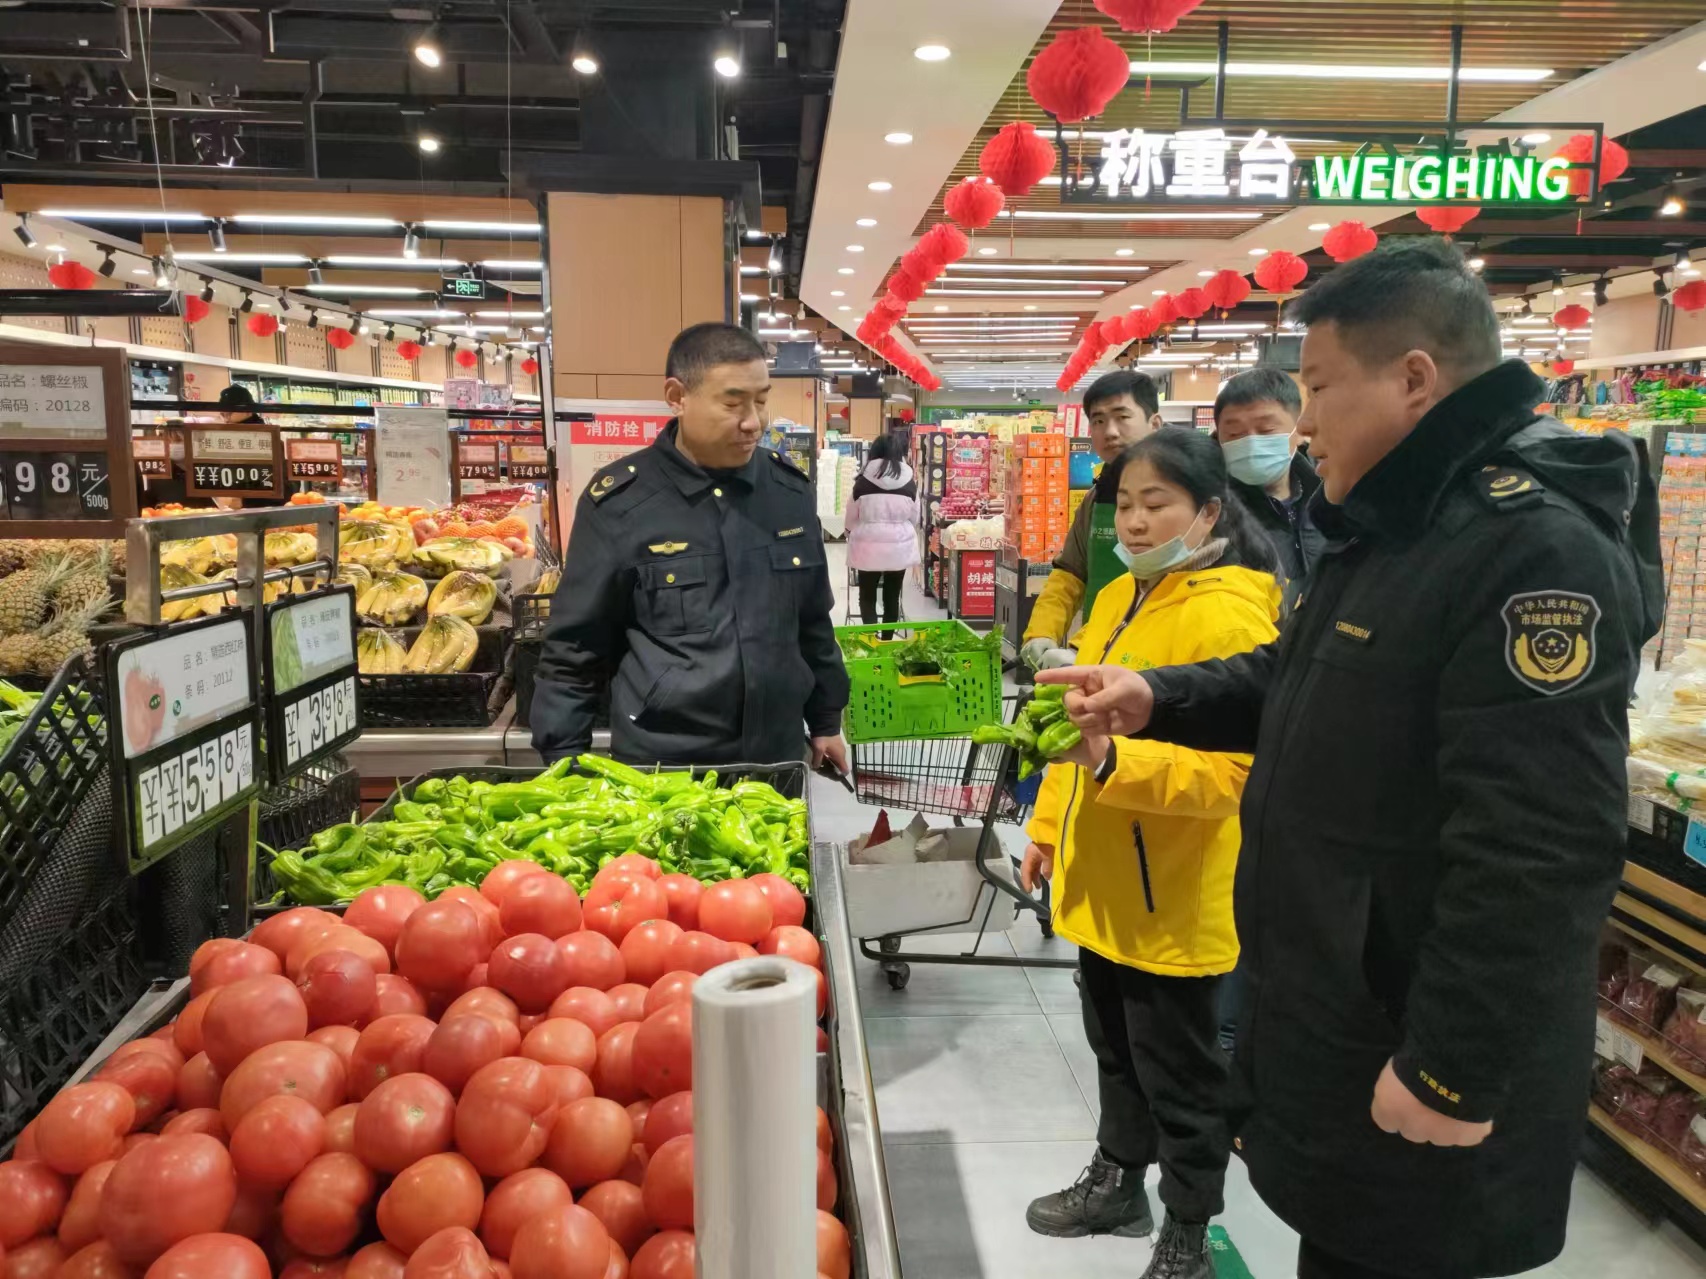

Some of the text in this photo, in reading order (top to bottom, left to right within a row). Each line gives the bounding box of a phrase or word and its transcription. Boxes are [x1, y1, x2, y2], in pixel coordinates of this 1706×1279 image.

[1099, 127, 1296, 197] 称重台
[1314, 154, 1571, 200] WEIGHING
[584, 420, 640, 438] 消防栓
[1514, 598, 1590, 615] 中华人民共和国
